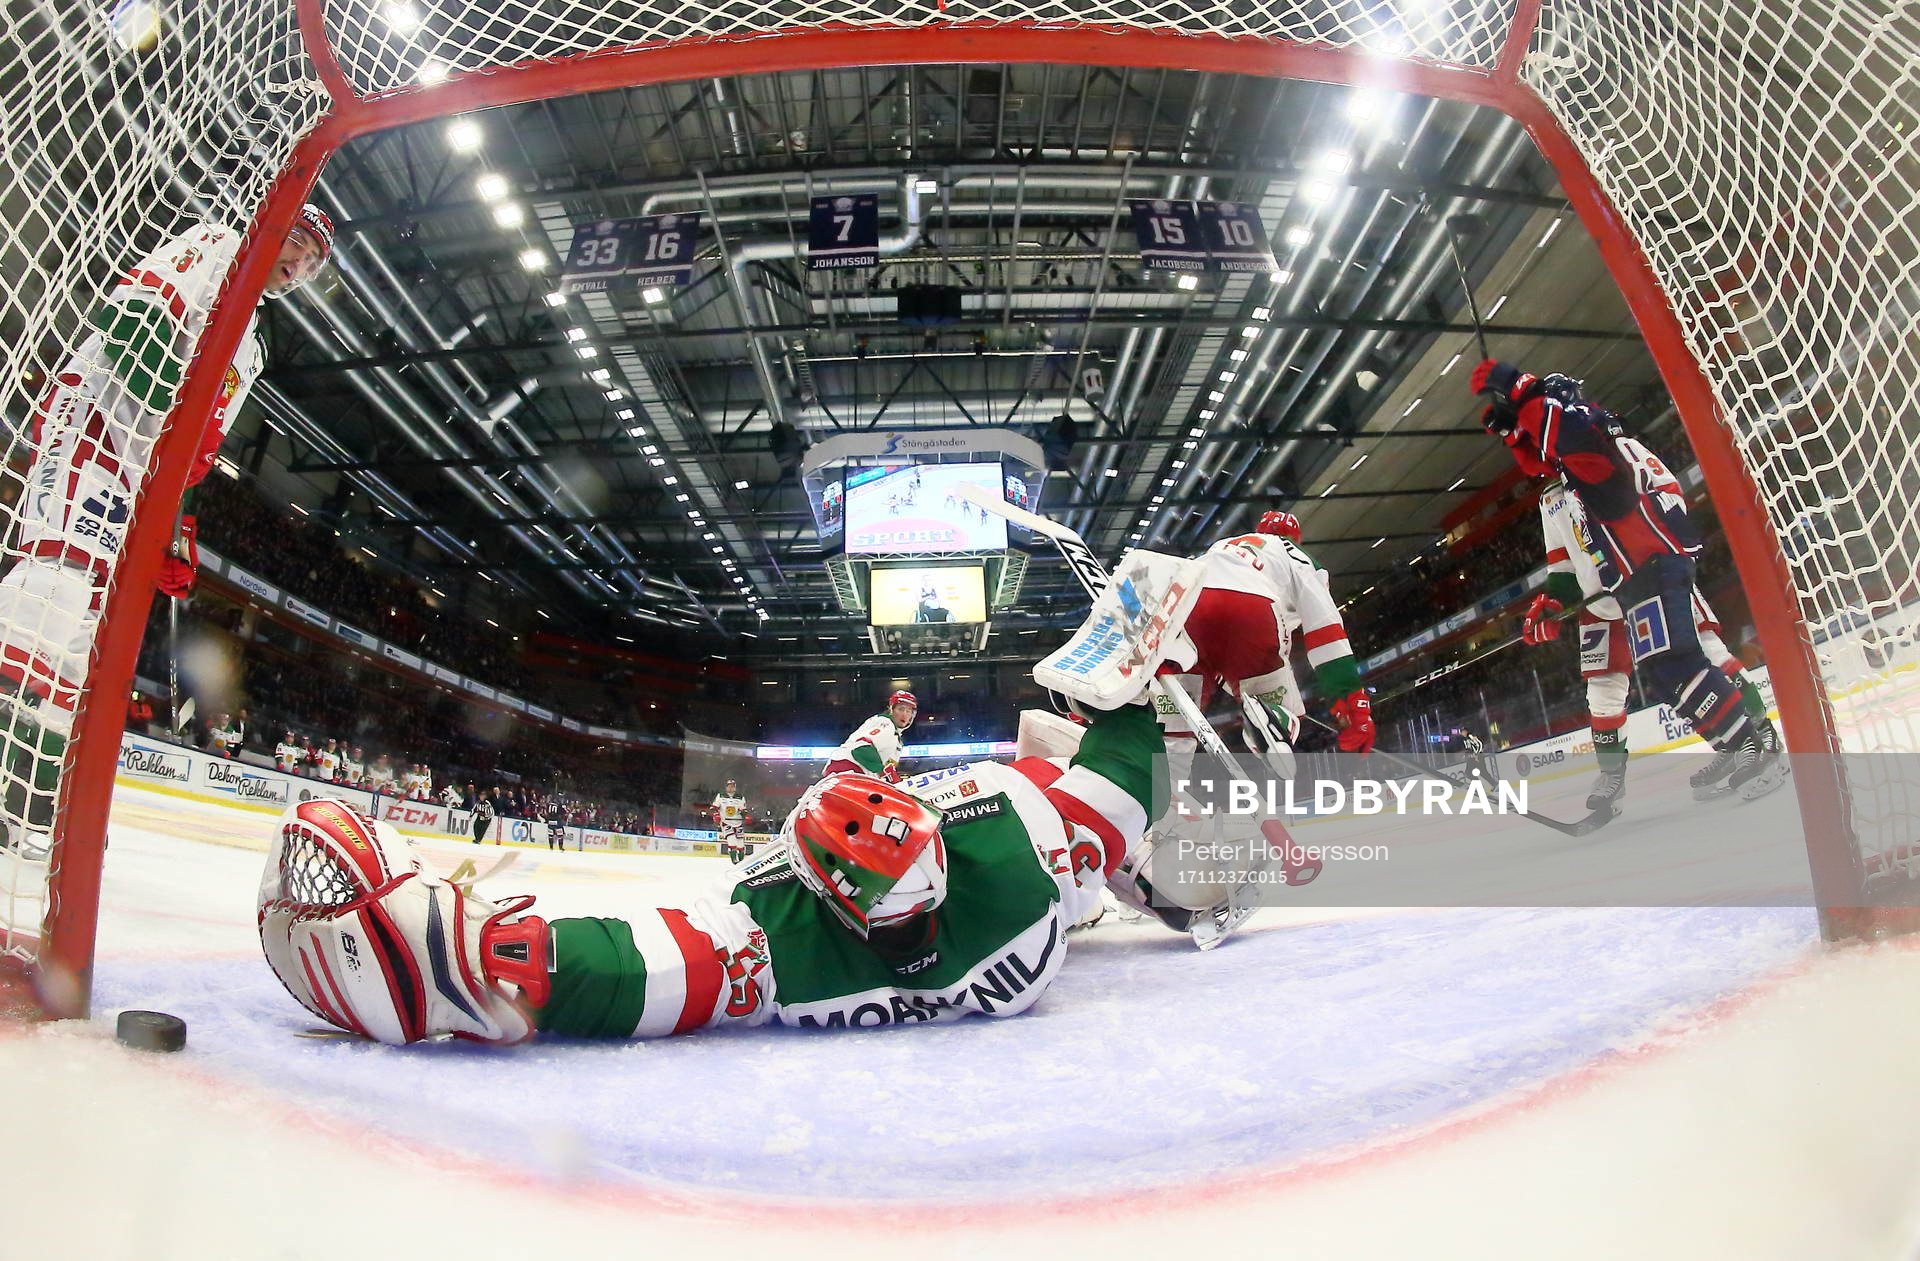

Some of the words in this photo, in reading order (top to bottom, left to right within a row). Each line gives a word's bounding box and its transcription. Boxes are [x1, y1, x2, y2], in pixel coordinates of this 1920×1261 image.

[833, 215, 854, 241] 7
[1150, 217, 1187, 244] 15
[1218, 219, 1254, 246] 10
[576, 237, 620, 267] 33
[645, 232, 681, 261] 16
[812, 256, 875, 269] JOHANSSON
[1150, 258, 1204, 271] JACOBSSON
[637, 274, 677, 287] HELBER
[901, 437, 966, 450] Stångåstaden
[239, 574, 267, 596] Nordea
[1072, 615, 1115, 659] PREFAB
[1053, 656, 1078, 671] AB
[1073, 631, 1124, 676] GUNNAR
[1414, 660, 1460, 688] CCM
[126, 750, 177, 779] Reklam
[1533, 750, 1565, 769] SAAB
[208, 762, 242, 785] Dekor
[238, 777, 278, 800] Reklam
[385, 804, 438, 826] CCM
[977, 800, 1000, 815] FM
[584, 834, 608, 846] CCM
